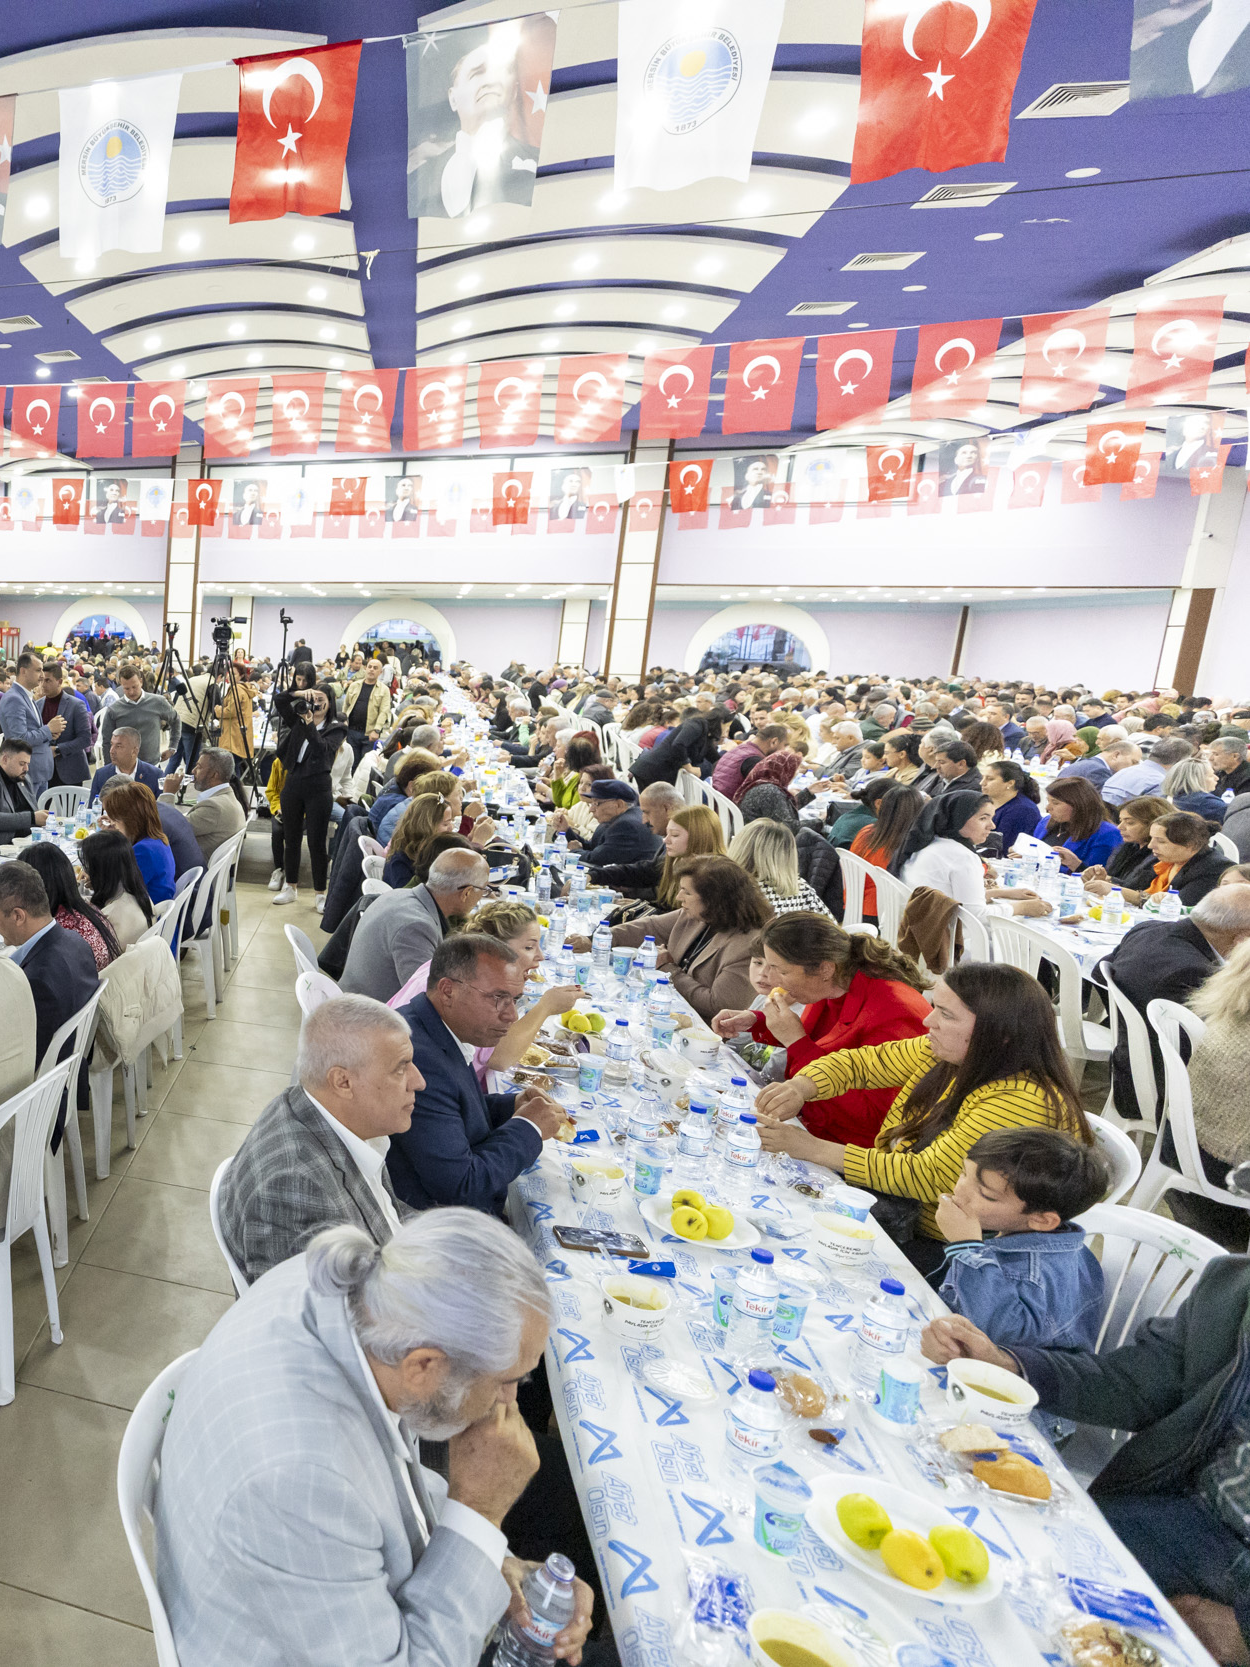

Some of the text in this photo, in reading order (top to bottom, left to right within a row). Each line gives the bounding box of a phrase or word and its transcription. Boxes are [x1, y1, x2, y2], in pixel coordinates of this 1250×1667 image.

[717, 33, 739, 81] BELEDİYESİ
[675, 120, 698, 132] 1873
[81, 146, 93, 176] MERSİN
[645, 1130, 658, 1138] Teki
[730, 1151, 748, 1162] Tekir
[745, 1300, 768, 1314] Tekir
[861, 1324, 882, 1342] Tekir
[563, 1381, 581, 1420] Olsun
[577, 1370, 604, 1409] Afiyet
[734, 1428, 762, 1448] Tekir
[653, 1442, 682, 1482] Olsun
[673, 1435, 707, 1481] Afiyet
[589, 1488, 609, 1537] Olsun
[605, 1473, 636, 1525] Afiyet
[636, 1608, 670, 1667] Afiye
